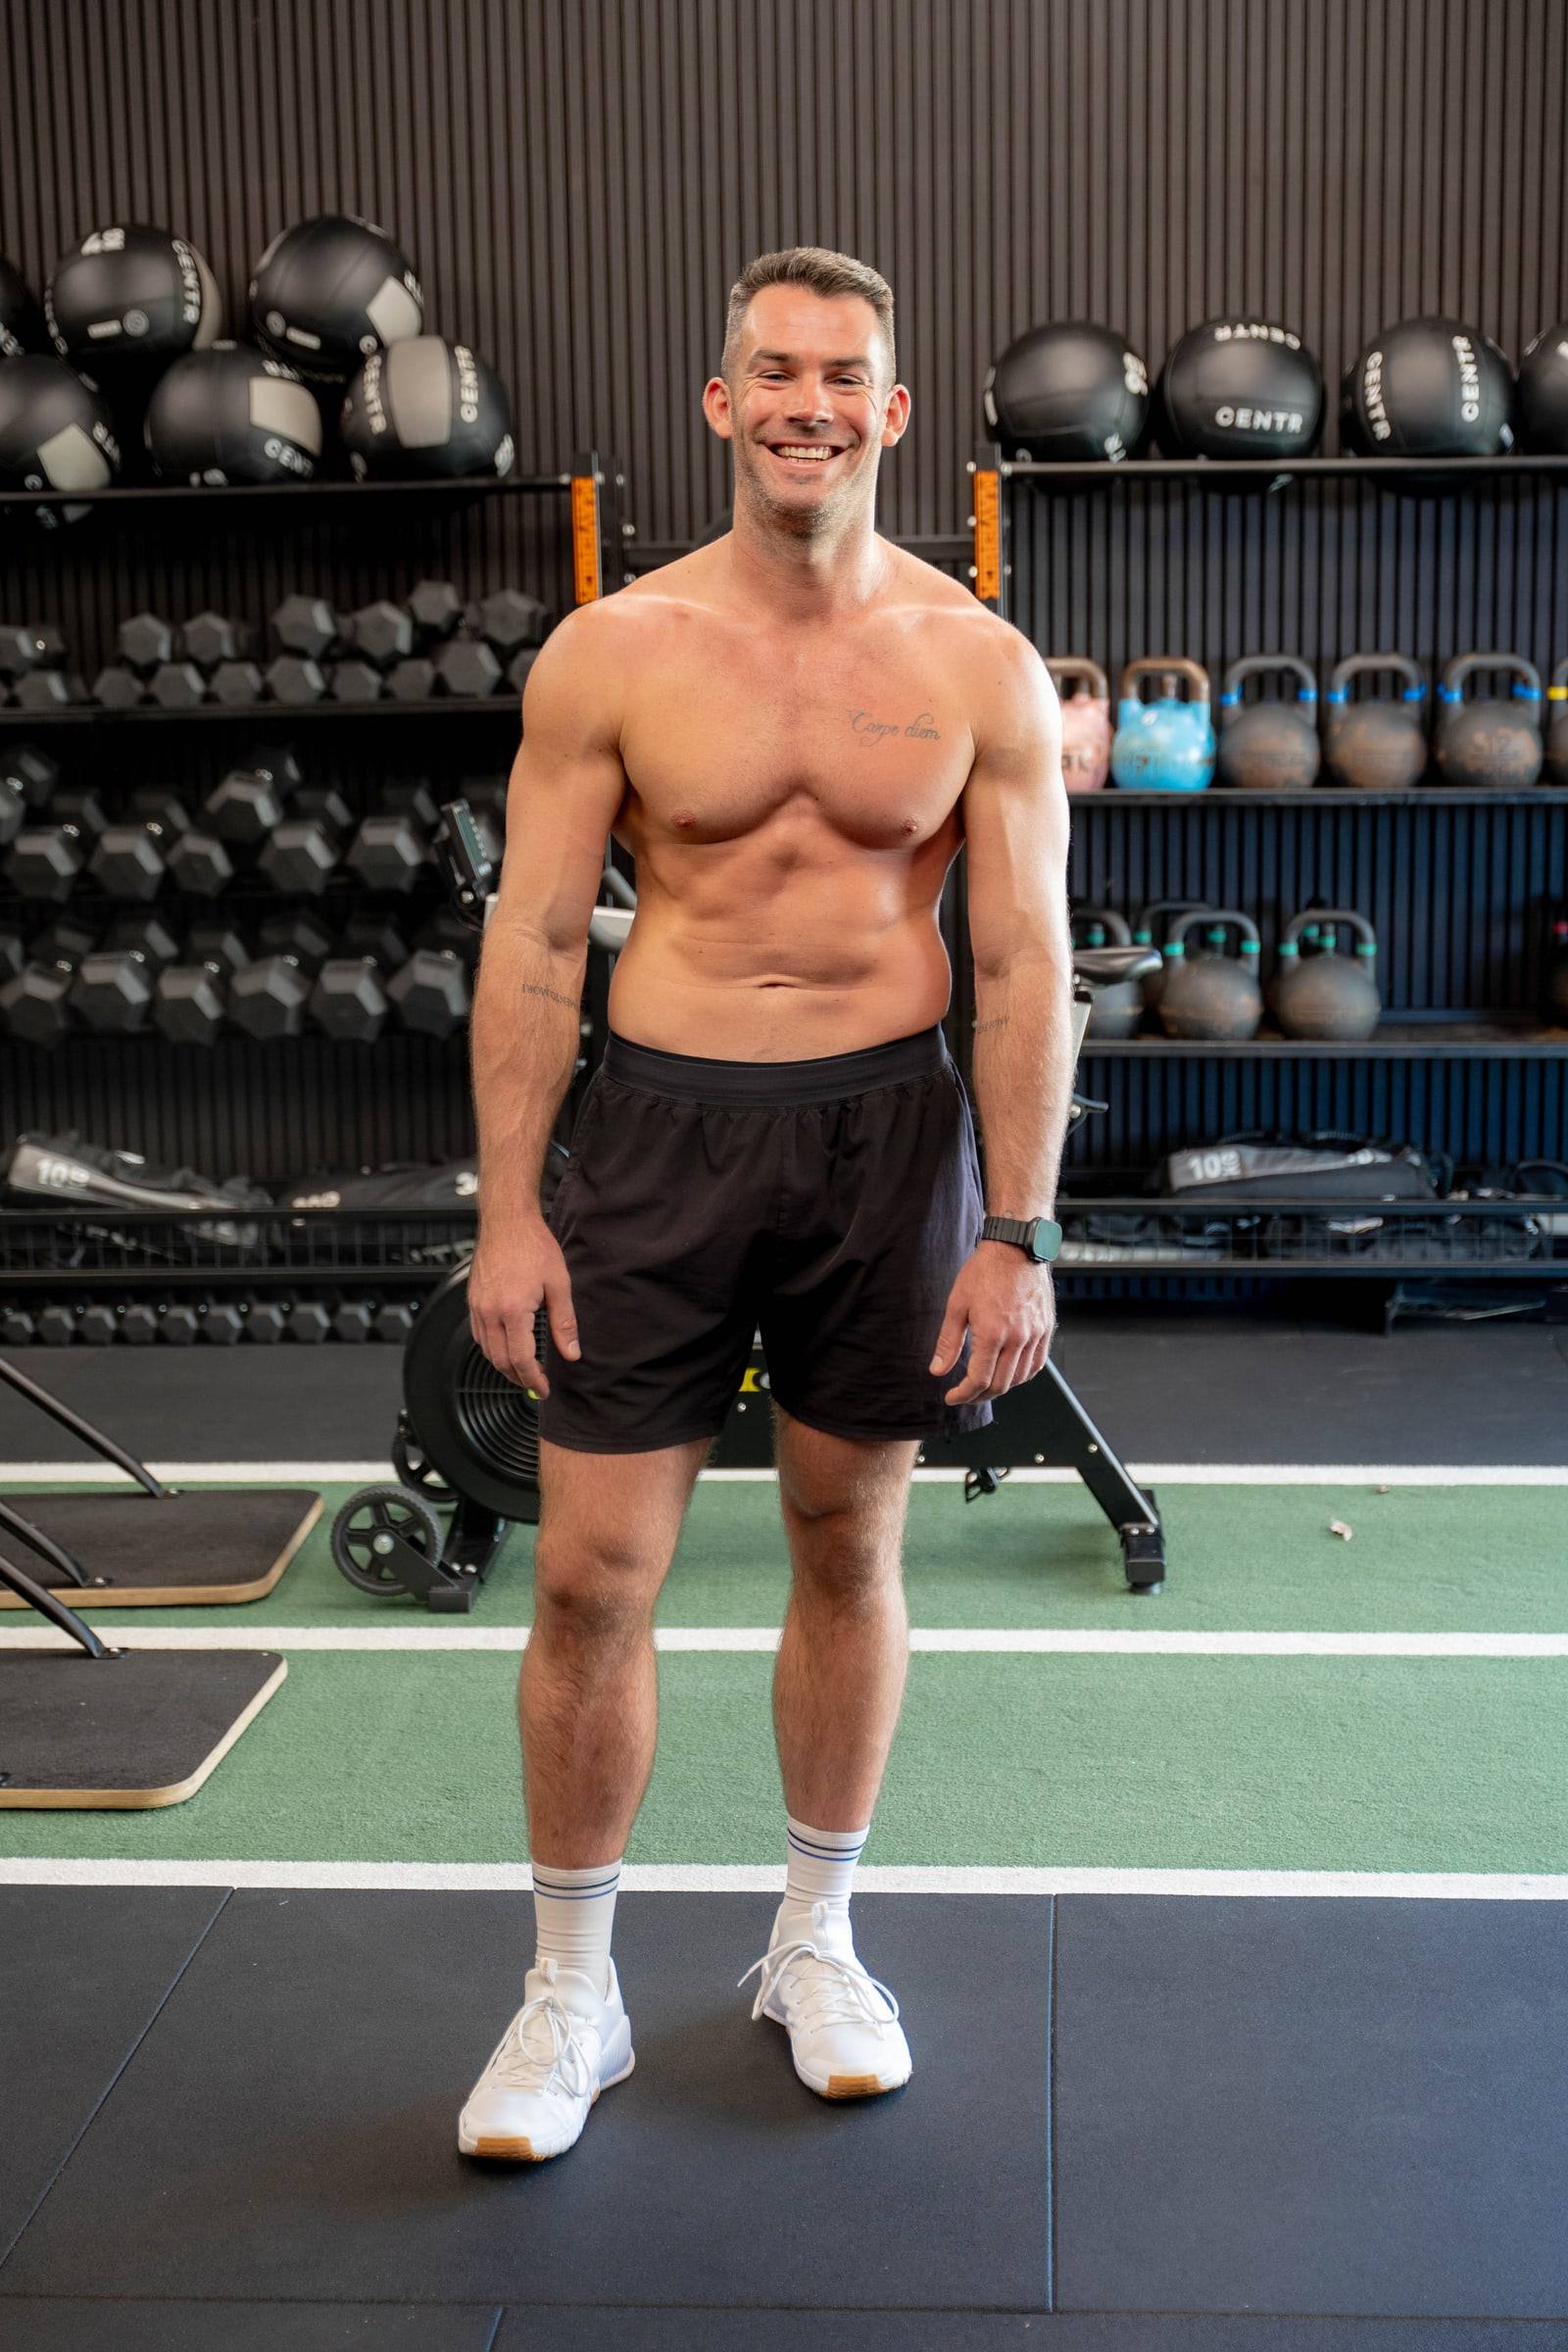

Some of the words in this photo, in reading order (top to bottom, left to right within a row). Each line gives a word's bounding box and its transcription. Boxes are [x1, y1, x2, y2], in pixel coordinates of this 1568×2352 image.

[454, 345, 479, 423] CENTR
[1364, 351, 1392, 442] CENTR
[1451, 335, 1481, 423] CENTR
[1214, 405, 1304, 434] CENTR
[846, 710, 900, 747] Carpe
[905, 712, 942, 741] diem
[1191, 1153, 1222, 1181] 10
